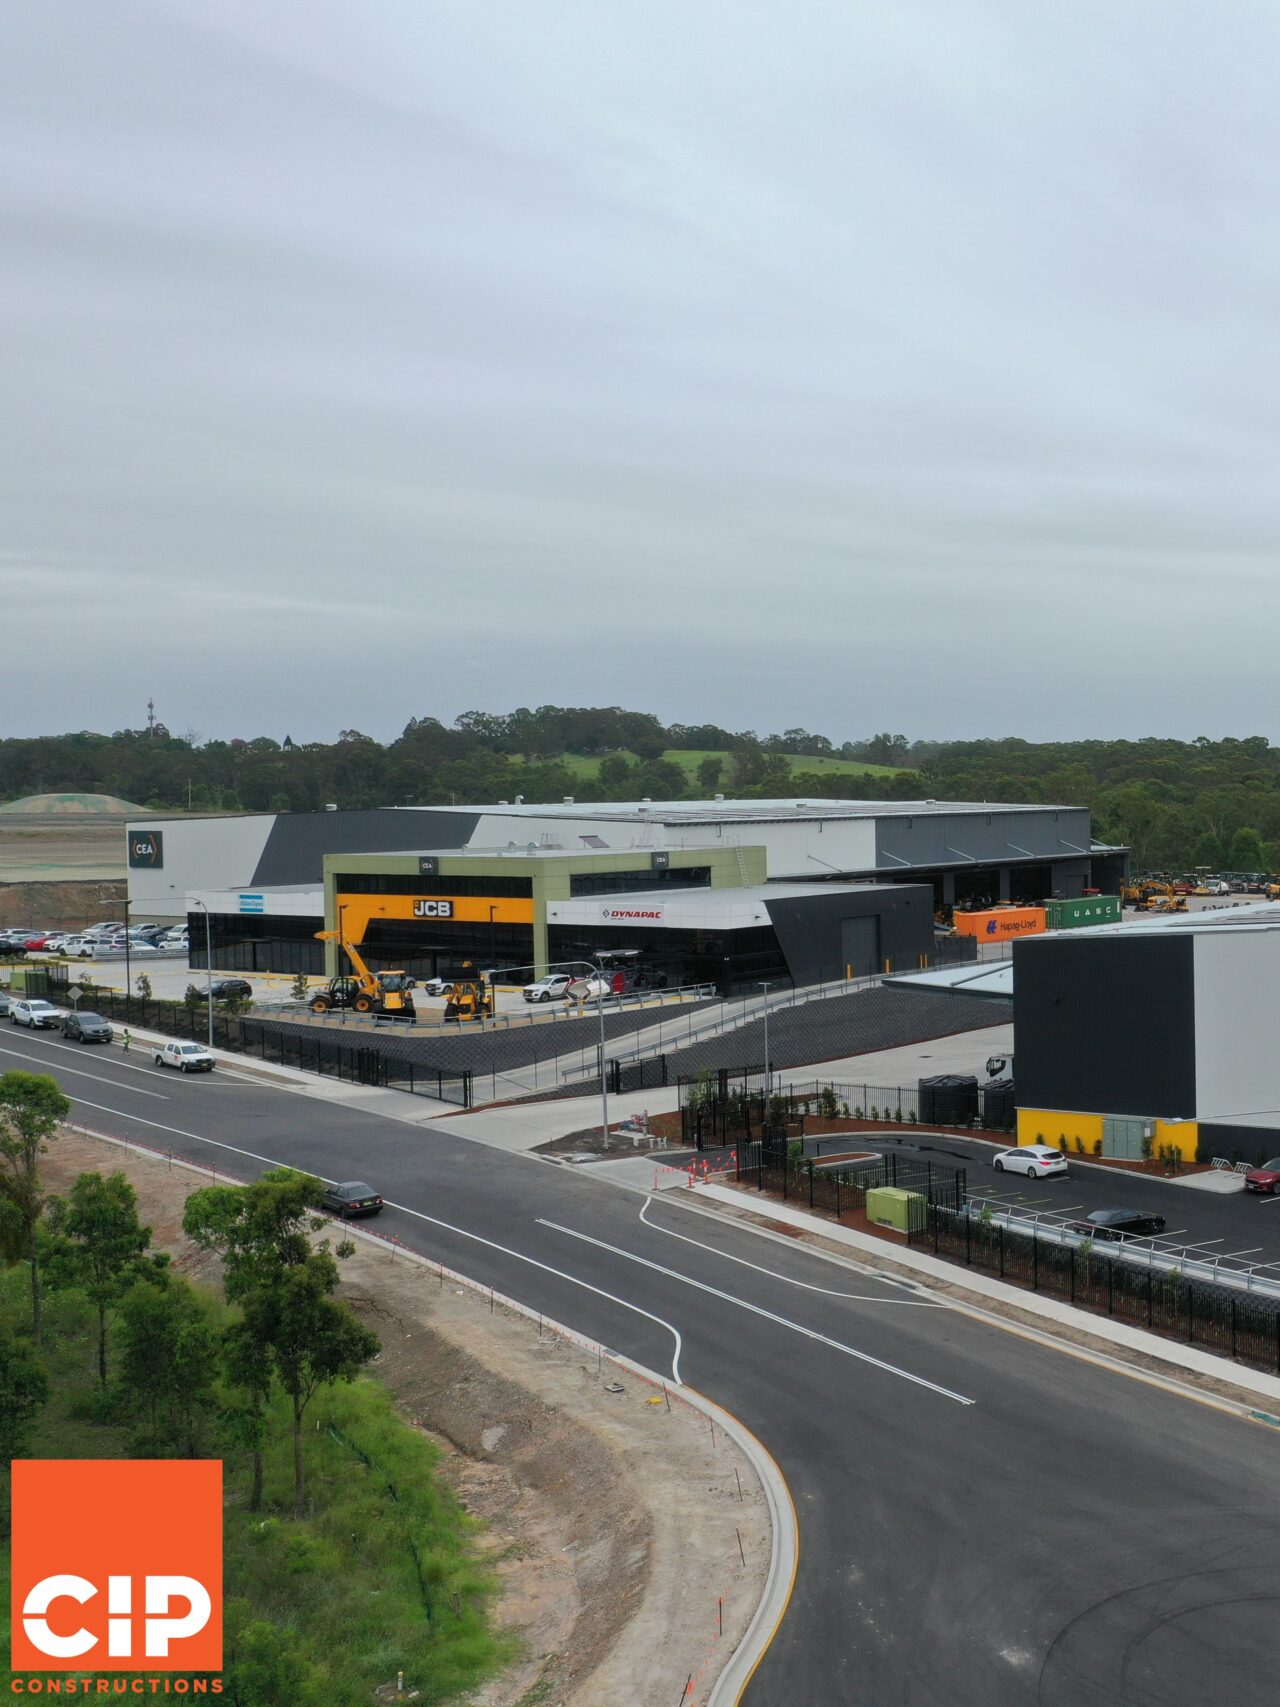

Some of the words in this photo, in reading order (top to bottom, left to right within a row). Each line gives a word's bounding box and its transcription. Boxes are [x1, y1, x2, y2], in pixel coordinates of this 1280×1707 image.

[136, 844, 153, 854] CEA
[415, 901, 450, 916] JCB
[611, 910, 662, 918] DYNAPAC
[1000, 919, 1036, 931] Hapag-Lloyd
